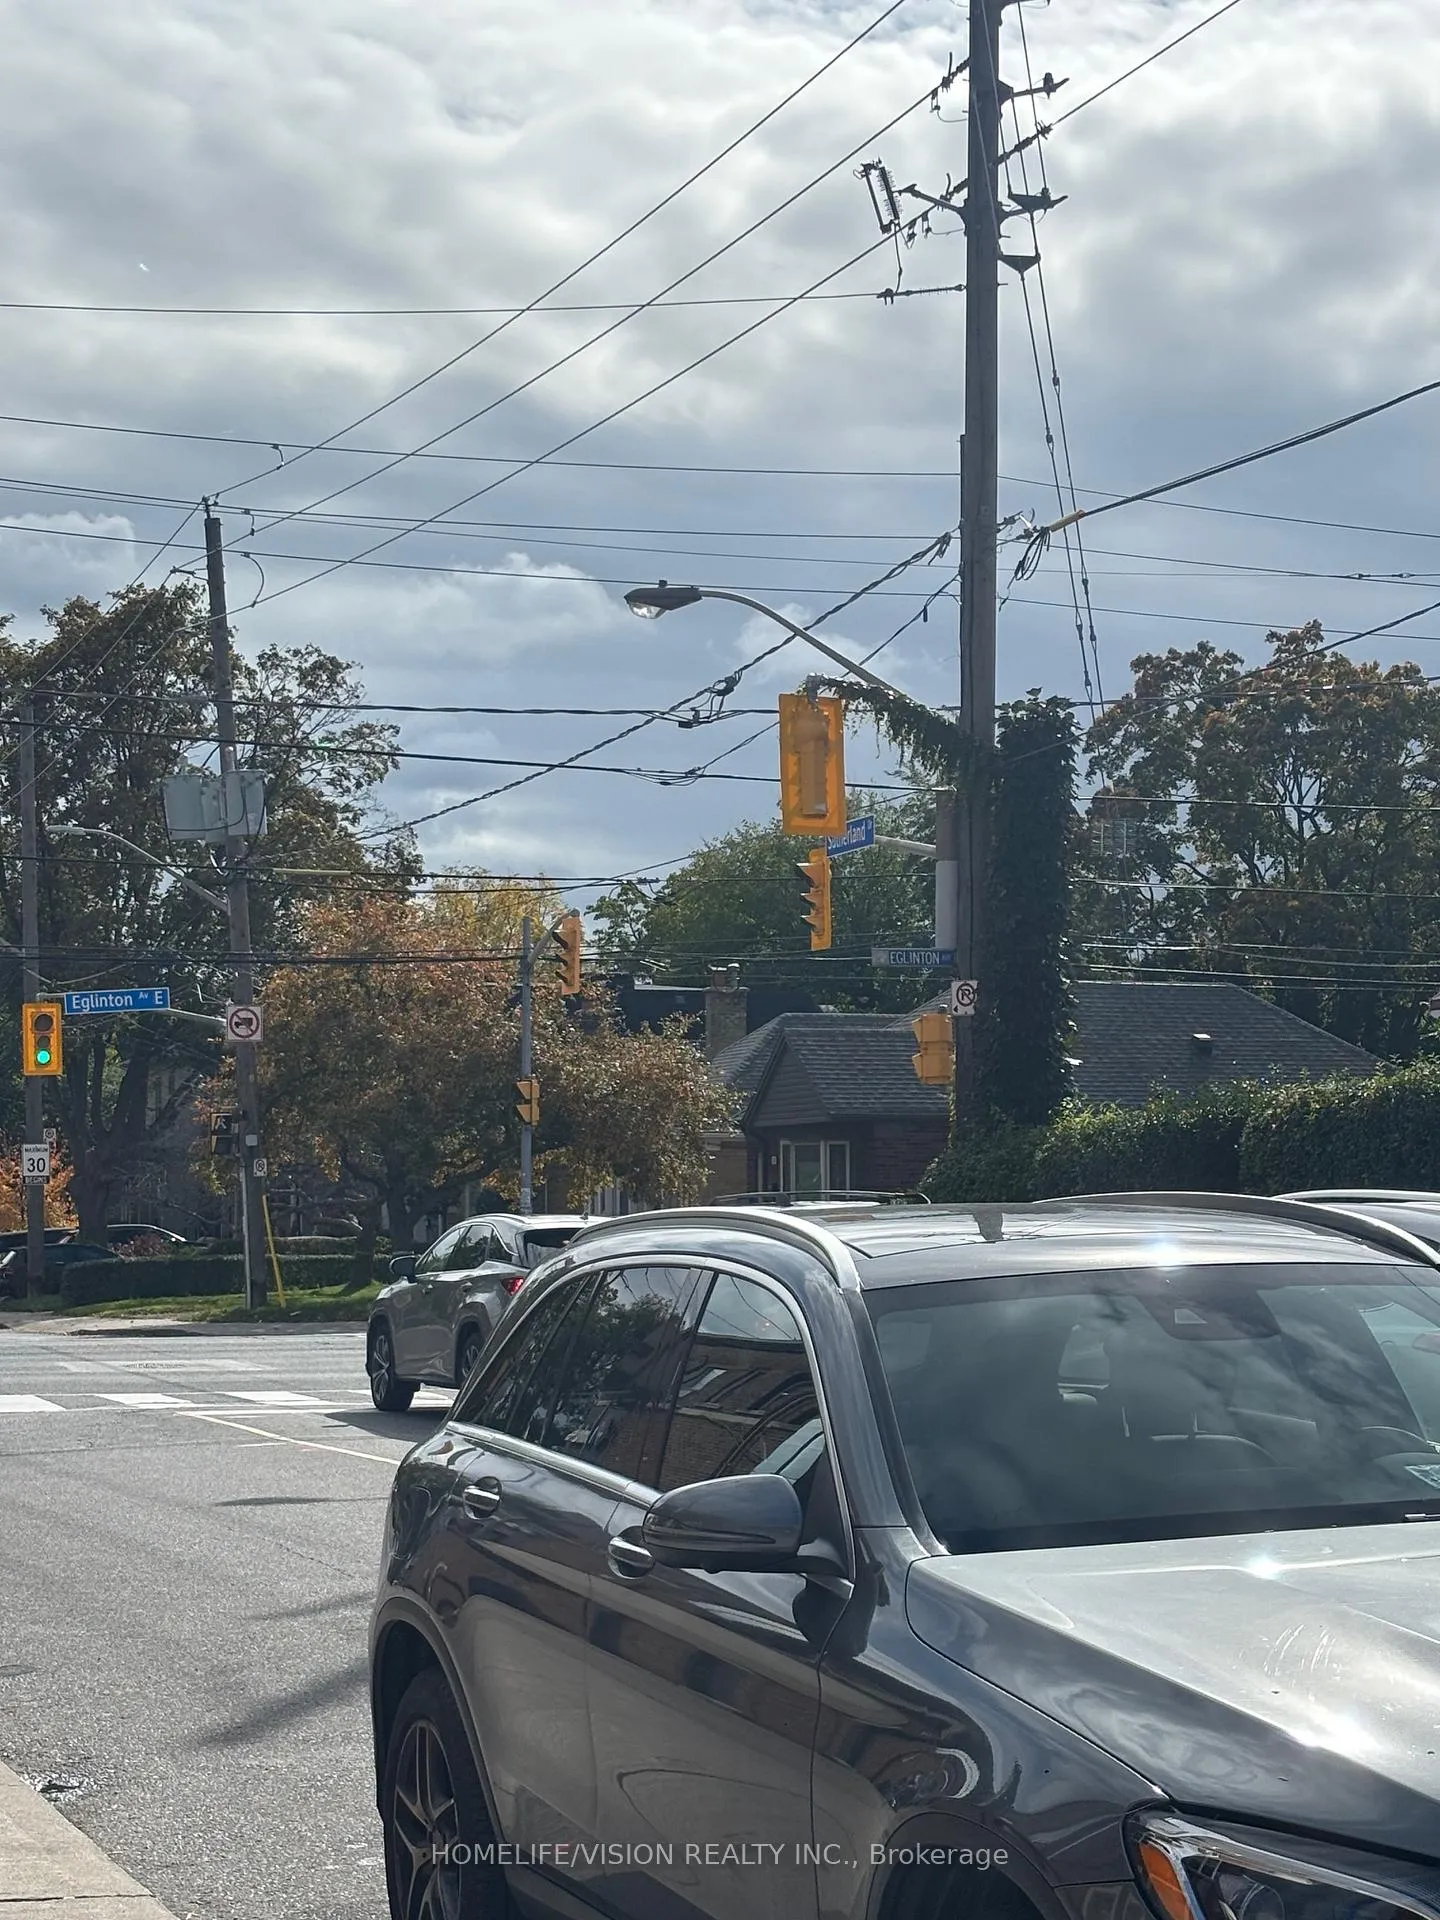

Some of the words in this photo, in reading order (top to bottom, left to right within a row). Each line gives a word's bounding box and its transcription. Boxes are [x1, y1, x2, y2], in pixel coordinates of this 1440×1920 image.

[890, 951, 940, 965] EGLINTON
[72, 993, 133, 1012] Eglinton
[138, 991, 149, 1000] Av
[154, 990, 163, 1005] E
[27, 1157, 46, 1173] 30
